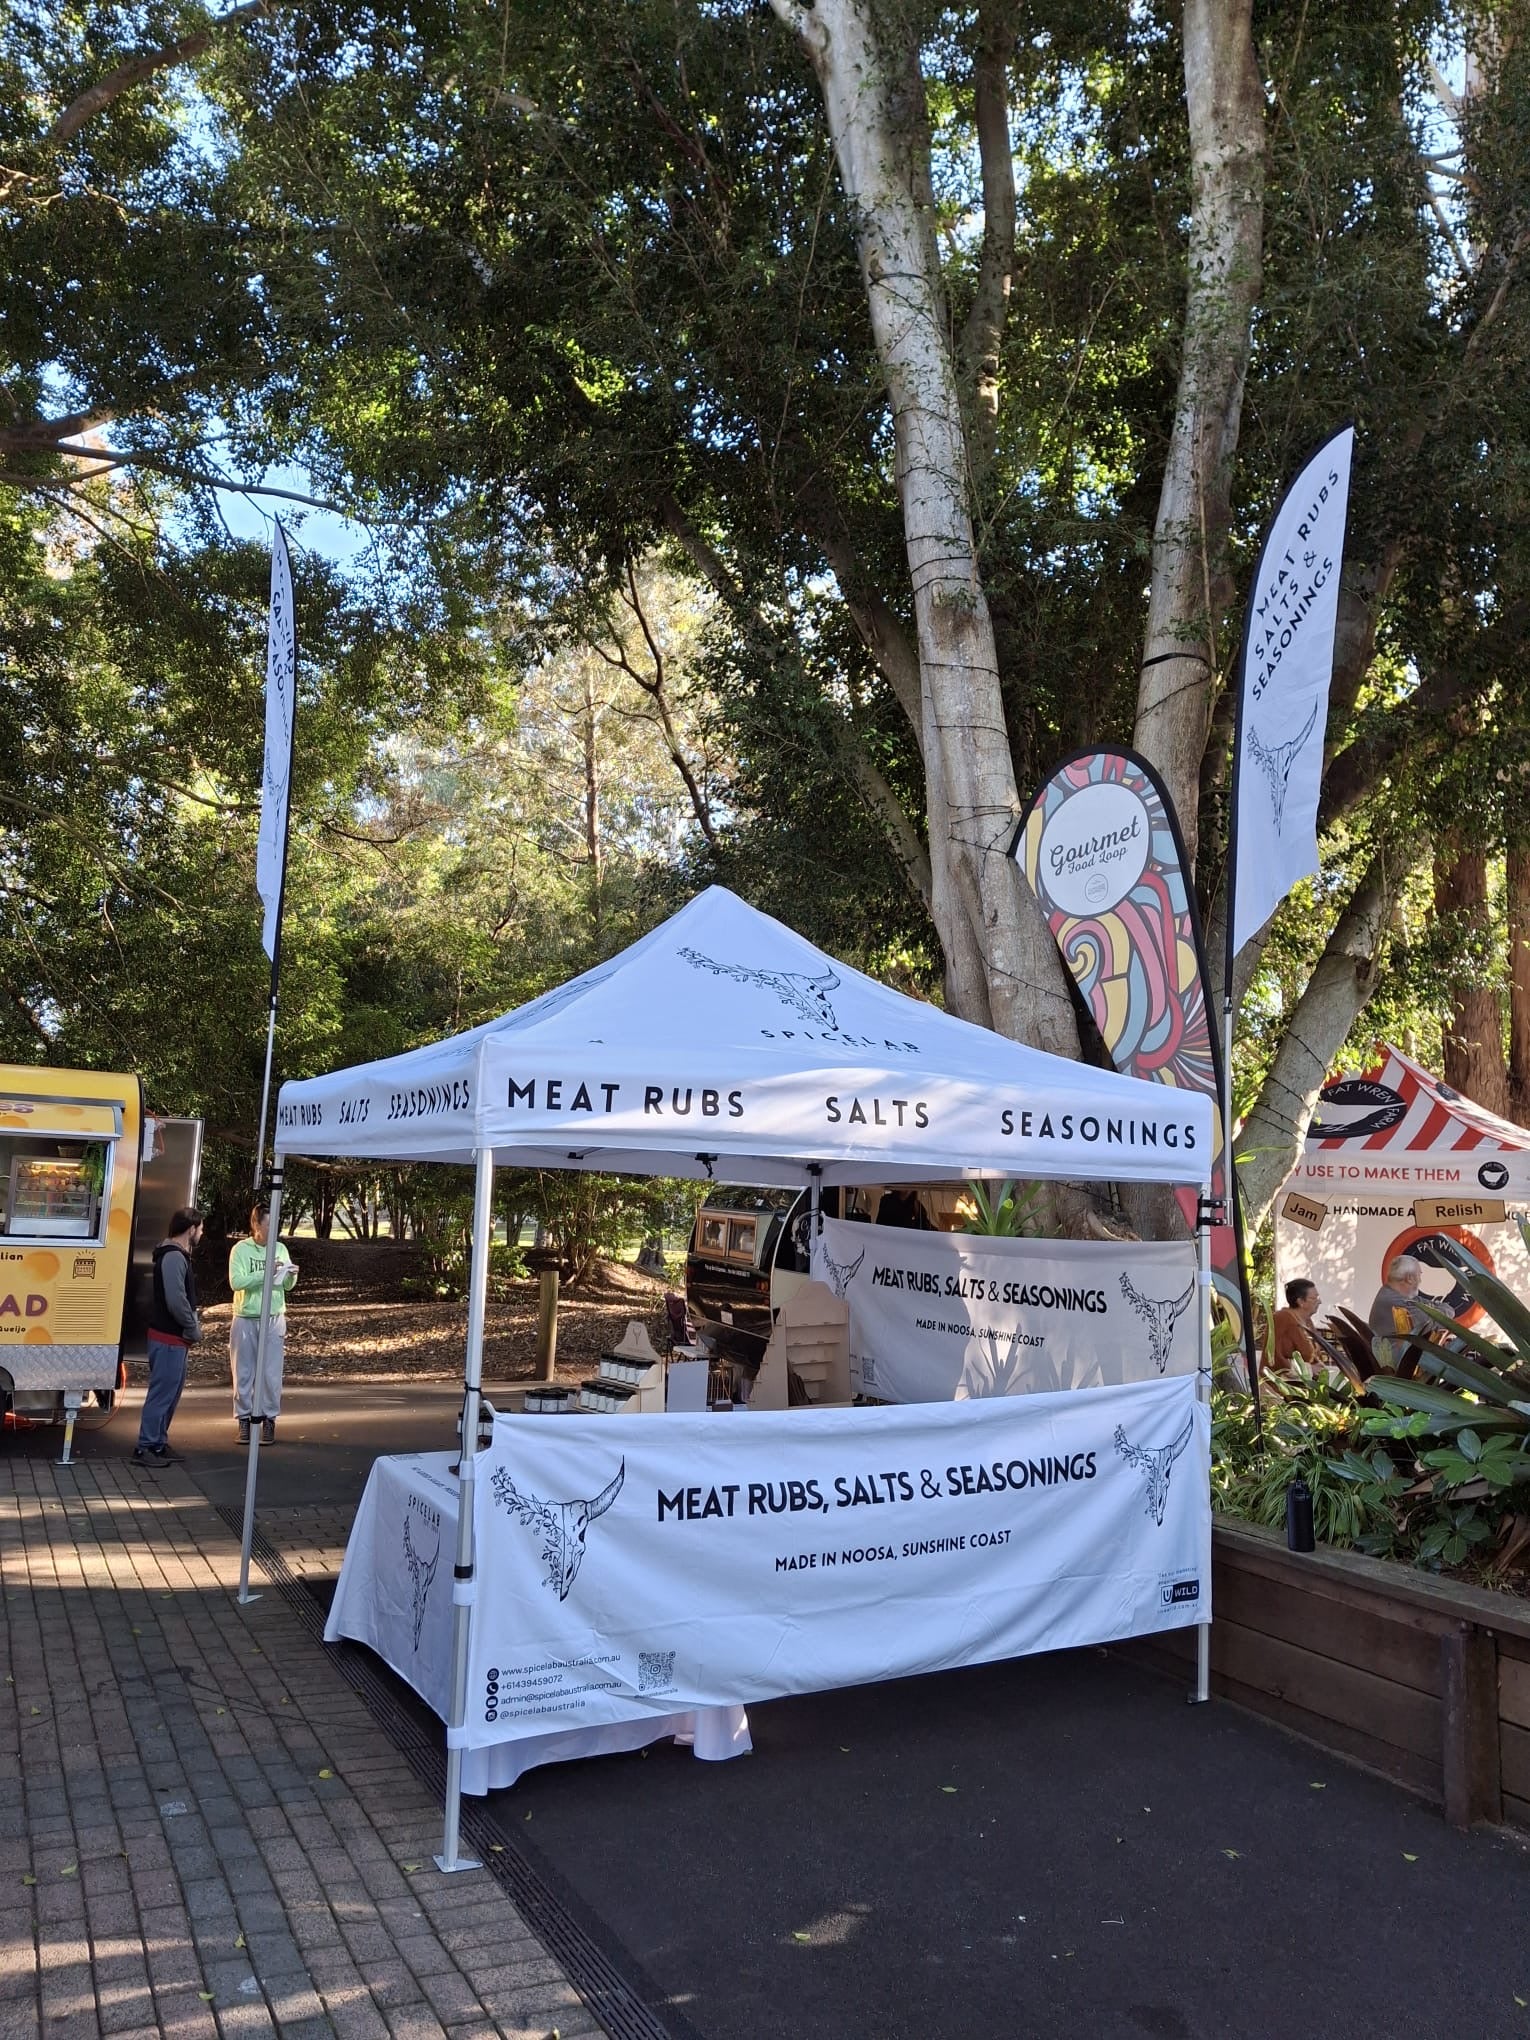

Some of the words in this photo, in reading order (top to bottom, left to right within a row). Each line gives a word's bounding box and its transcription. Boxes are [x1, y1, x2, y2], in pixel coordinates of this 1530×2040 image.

[1257, 549, 1297, 618] MEAT
[1297, 469, 1339, 541] RUBS
[1255, 579, 1298, 660] SALTS
[1303, 551, 1317, 568] &
[1252, 556, 1333, 701] SEASONINGS
[1050, 815, 1141, 876] Gourmet
[1067, 854, 1095, 874] Food
[1099, 847, 1127, 864] Loop
[761, 1029, 919, 1050] SPICELAB
[279, 1105, 297, 1126] MEAT
[300, 1103, 322, 1126] RUBS
[339, 1098, 370, 1124] SALTS
[387, 1079, 470, 1120] SEASONINGS
[1327, 1083, 1352, 1097] FAT
[1358, 1083, 1396, 1103] WREN
[508, 1077, 620, 1112] MEAT
[644, 1086, 744, 1117] RUBS
[825, 1096, 929, 1128] SALTS
[1001, 1110, 1196, 1149] SEASONINGS
[1370, 1107, 1399, 1129] FARM
[1306, 1165, 1334, 1178] USE
[1338, 1166, 1360, 1178] TO
[1364, 1167, 1409, 1180] MAKE
[1414, 1167, 1460, 1181] THEM
[1290, 1202, 1318, 1222] Jam
[1334, 1205, 1404, 1217] HANDMADE
[1436, 1202, 1483, 1218] Relish
[872, 1265, 905, 1290] MEAT
[906, 1270, 942, 1298] RUBS,
[945, 1273, 985, 1300] SALTS
[988, 1280, 1000, 1302] &
[1003, 1282, 1107, 1314] SEASONINGS
[916, 1318, 937, 1332] MADE
[938, 1322, 946, 1333] IN
[979, 1327, 1017, 1344] SUNSHINE
[1018, 1334, 1045, 1348] COAST
[657, 1485, 740, 1521] MEAT
[748, 1479, 829, 1514] RUBS,
[836, 1470, 914, 1507] SALTS
[920, 1468, 943, 1499] &
[948, 1451, 1097, 1496] SEASONINGS
[408, 1494, 440, 1527] SPICELAB
[775, 1553, 817, 1572] MADE
[821, 1551, 837, 1567] IN
[841, 1545, 898, 1565] NOOSA,
[902, 1535, 966, 1558] SUNSHINE
[969, 1529, 1012, 1548] COAST
[1175, 1586, 1197, 1597] WILD
[501, 1674, 563, 1691] +61439459072
[500, 1700, 586, 1720] @spicelabaustralia
